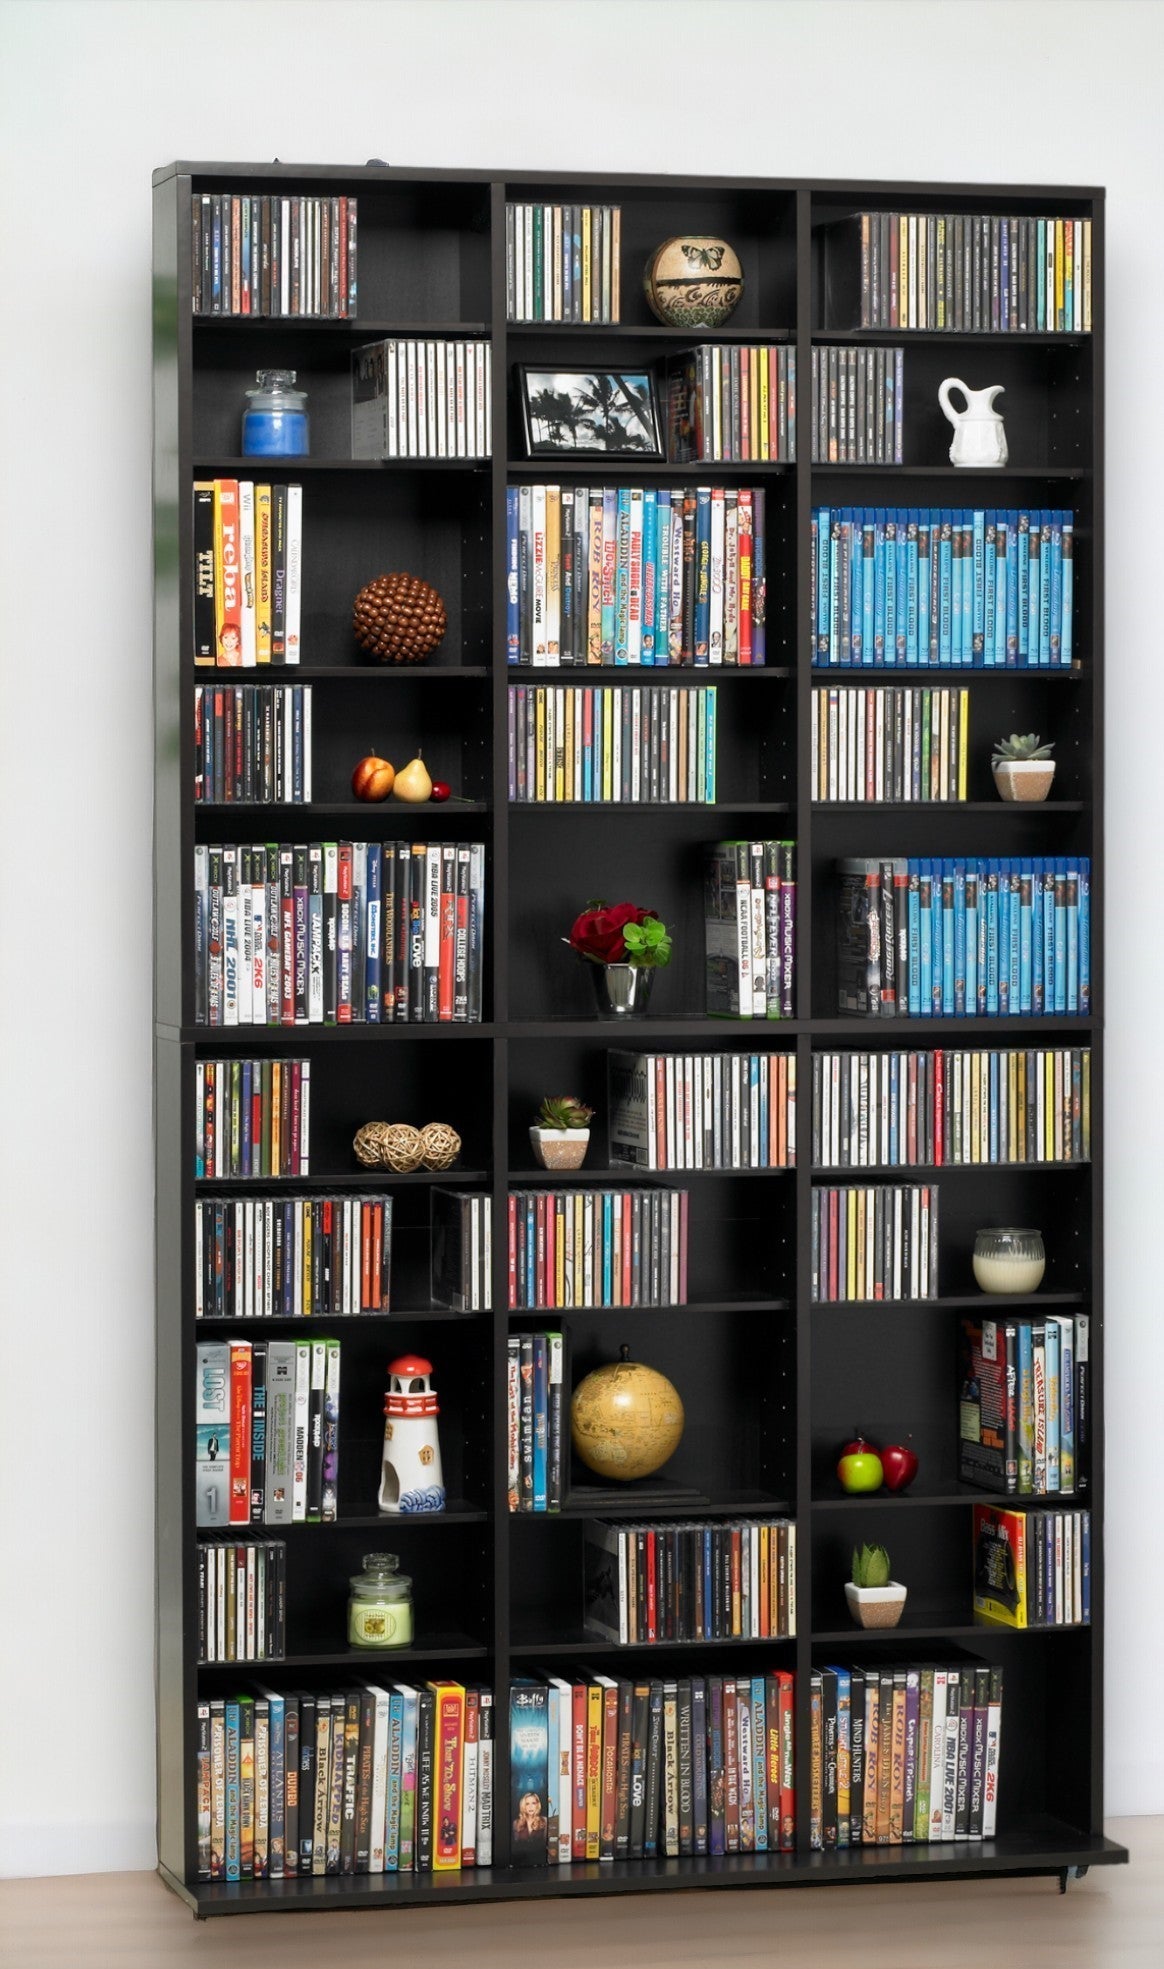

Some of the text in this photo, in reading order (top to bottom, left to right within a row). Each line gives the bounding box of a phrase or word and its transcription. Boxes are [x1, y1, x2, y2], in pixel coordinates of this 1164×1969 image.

[620, 512, 628, 568] ALADDIN
[728, 543, 736, 567] Jekyll
[199, 550, 213, 597] TILT
[222, 523, 238, 612] reba
[631, 532, 640, 620] PAULY SHORE DEAD
[674, 527, 682, 606] Westward Ho
[741, 556, 750, 580] DADDY
[275, 570, 284, 614] Dragnet
[508, 572, 517, 604] NEMO
[592, 571, 601, 613] ROY
[644, 562, 653, 626] UNDERCLASSMAN
[883, 889, 893, 901] 7
[297, 924, 306, 958] MUSIC
[457, 929, 465, 982] COLLEGE HOOPS
[227, 919, 235, 999] NHL 2001
[742, 960, 748, 969] 06
[784, 955, 792, 989] MIXER
[204, 1368, 224, 1412] LOST
[1034, 1358, 1045, 1415] TREASURE
[254, 1386, 265, 1460] THE INSIDE
[522, 1396, 532, 1462] swimfan
[296, 1472, 303, 1482] 06
[214, 1725, 222, 1776] PRISONER
[444, 1737, 457, 1762] That
[853, 1719, 862, 1783] MIND HUNTERS
[882, 1719, 890, 1754] JAMES
[933, 1726, 942, 1769] CAROLINA
[228, 1728, 237, 1785] ALADDIN
[302, 1746, 312, 1771] darkness
[362, 1746, 371, 1780] PIRATES
[681, 1706, 690, 1813] WRITTEN IN BLOOD
[868, 1752, 877, 1792] ROY
[882, 1759, 890, 1788] DEAN
[894, 1753, 903, 1793] ROY
[959, 1744, 968, 1777] MUSIC
[975, 1745, 983, 1777] MUSIC
[215, 1778, 222, 1791] OF
[259, 1779, 266, 1791] OF
[288, 1772, 297, 1806] DUMBO
[316, 1747, 326, 1832] Black Arrow
[332, 1733, 342, 1824] KIDNAPPED
[345, 1755, 355, 1820] TRAFFIC
[422, 1775, 429, 1784] AS
[743, 1780, 749, 1794] Ho
[944, 1737, 955, 1814] NBA LIVE 2001
[359, 1797, 369, 1816] High
[422, 1787, 428, 1799] WE
[444, 1784, 455, 1811] Show
[482, 1792, 490, 1809] MAD
[958, 1779, 967, 1812] MIXER
[972, 1780, 982, 1813] MIXER
[228, 1820, 237, 1839] Magic
[482, 1811, 490, 1830] TRIX
